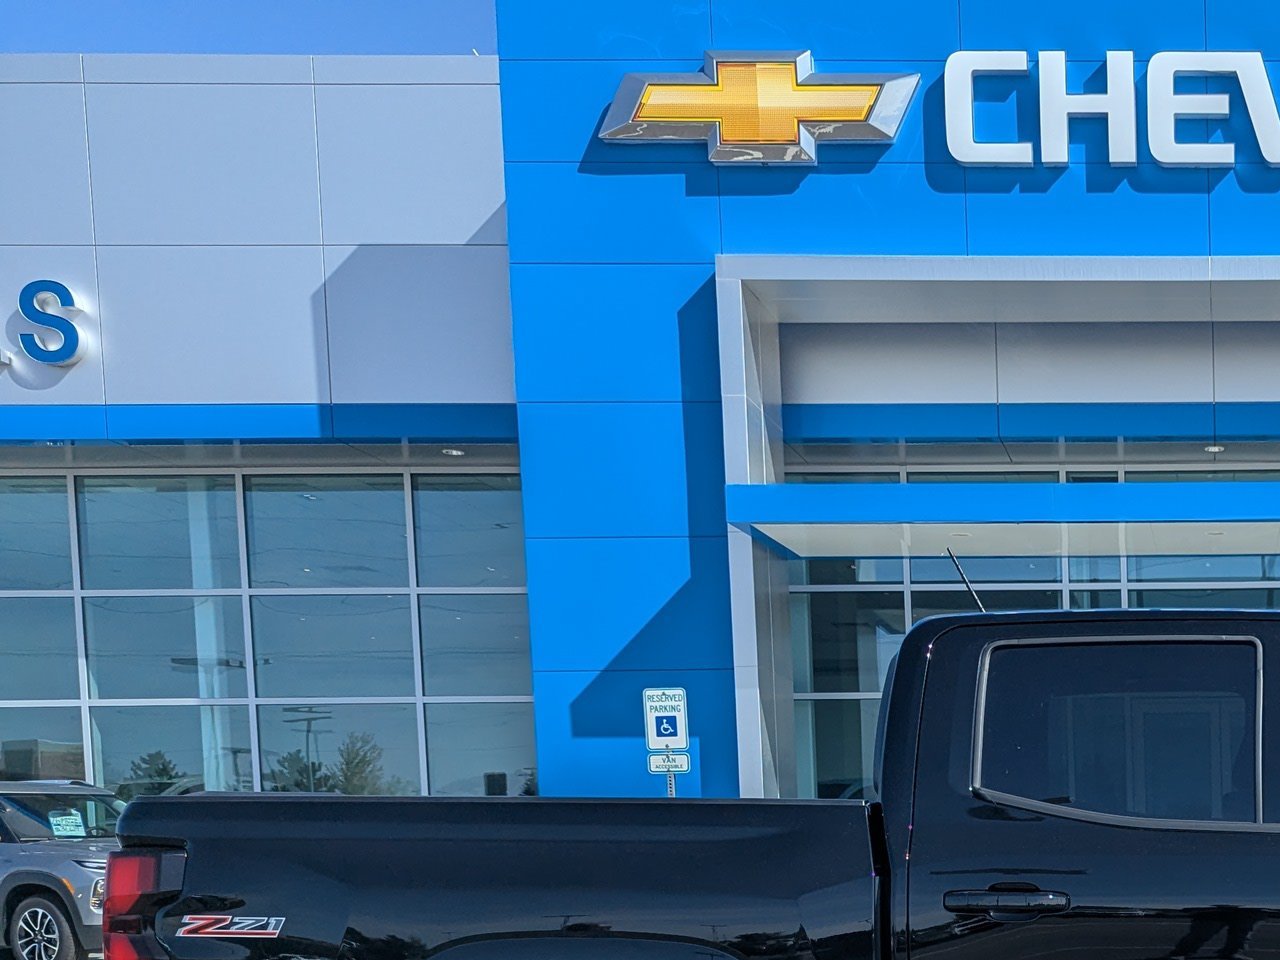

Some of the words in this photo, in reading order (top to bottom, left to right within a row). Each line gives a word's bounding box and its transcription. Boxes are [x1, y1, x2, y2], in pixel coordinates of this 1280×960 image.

[14, 279, 80, 365] S
[646, 693, 683, 703] RESERVED
[649, 704, 682, 713] PARKING
[175, 915, 286, 938] Z71
